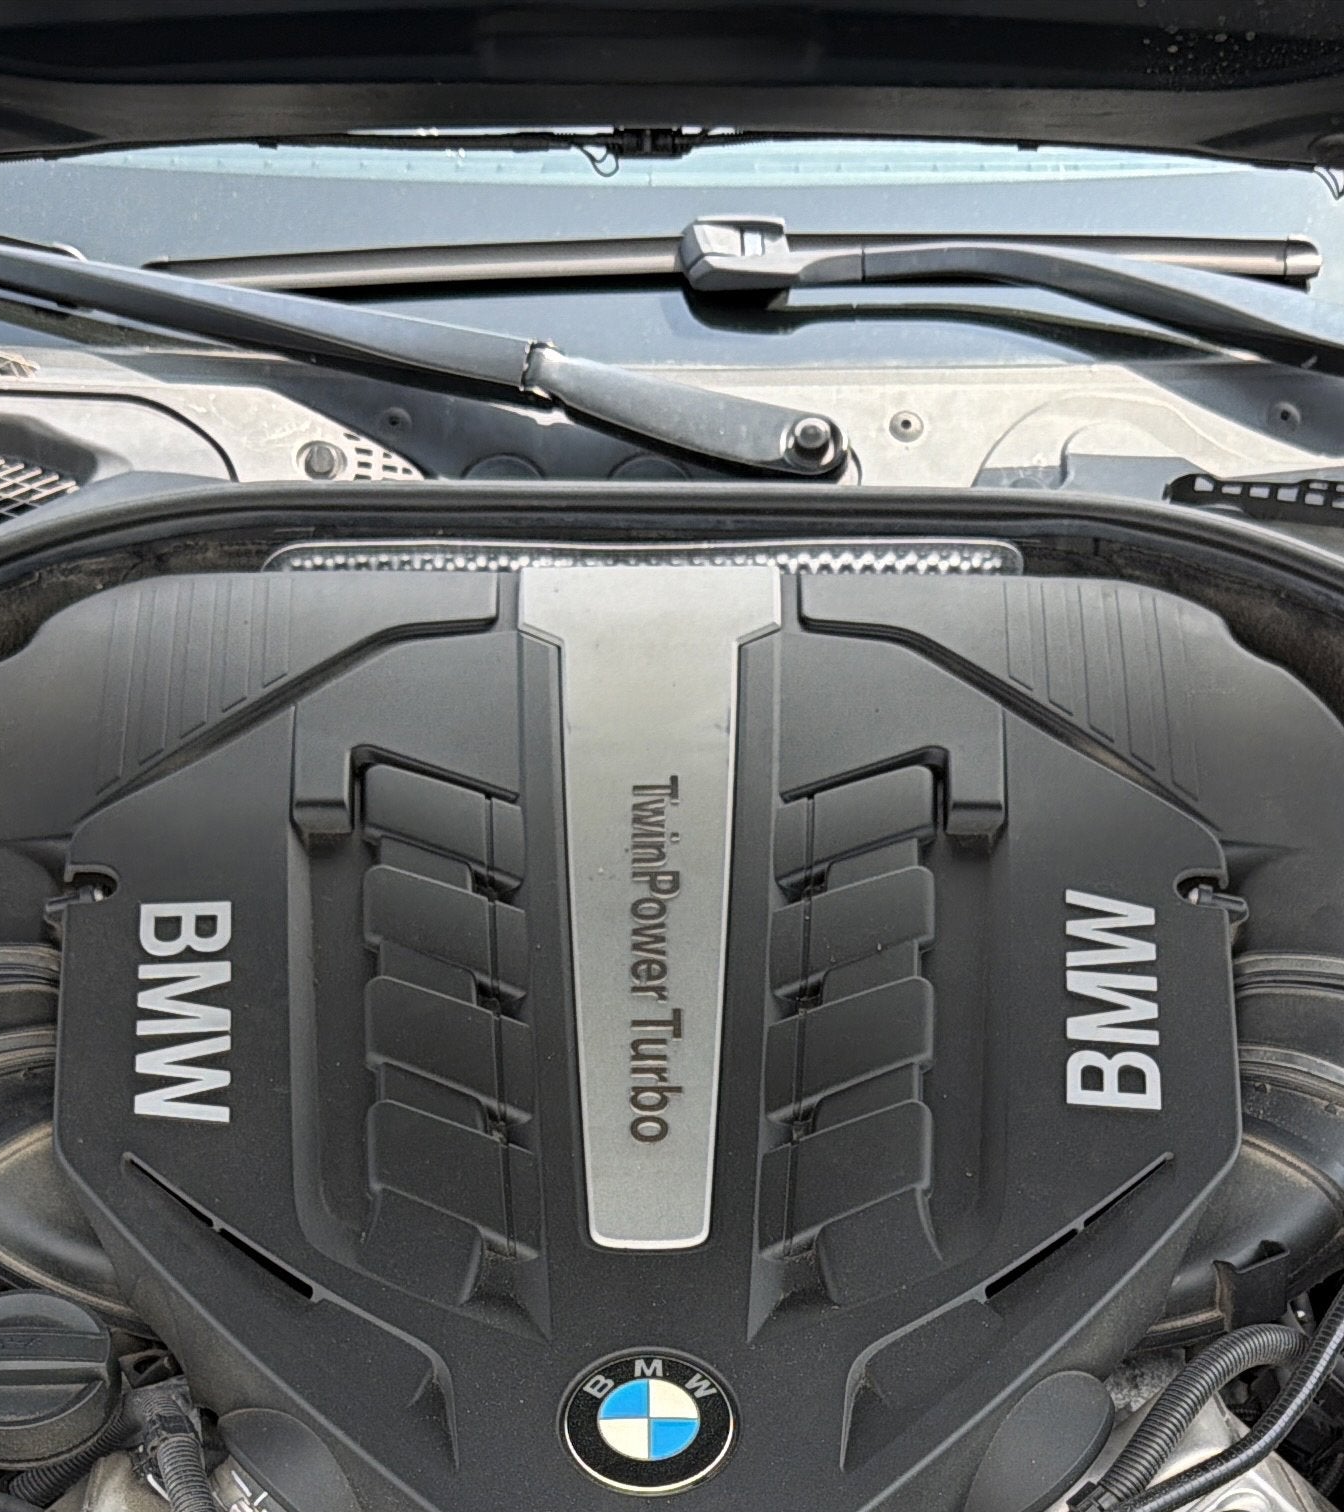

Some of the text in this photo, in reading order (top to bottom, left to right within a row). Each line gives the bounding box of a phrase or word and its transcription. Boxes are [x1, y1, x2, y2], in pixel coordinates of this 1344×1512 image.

[134, 901, 232, 1123] BMW
[630, 775, 683, 1144] TwinPower Turbo
[1065, 888, 1162, 1110] BMW
[582, 1358, 718, 1400] BMW
